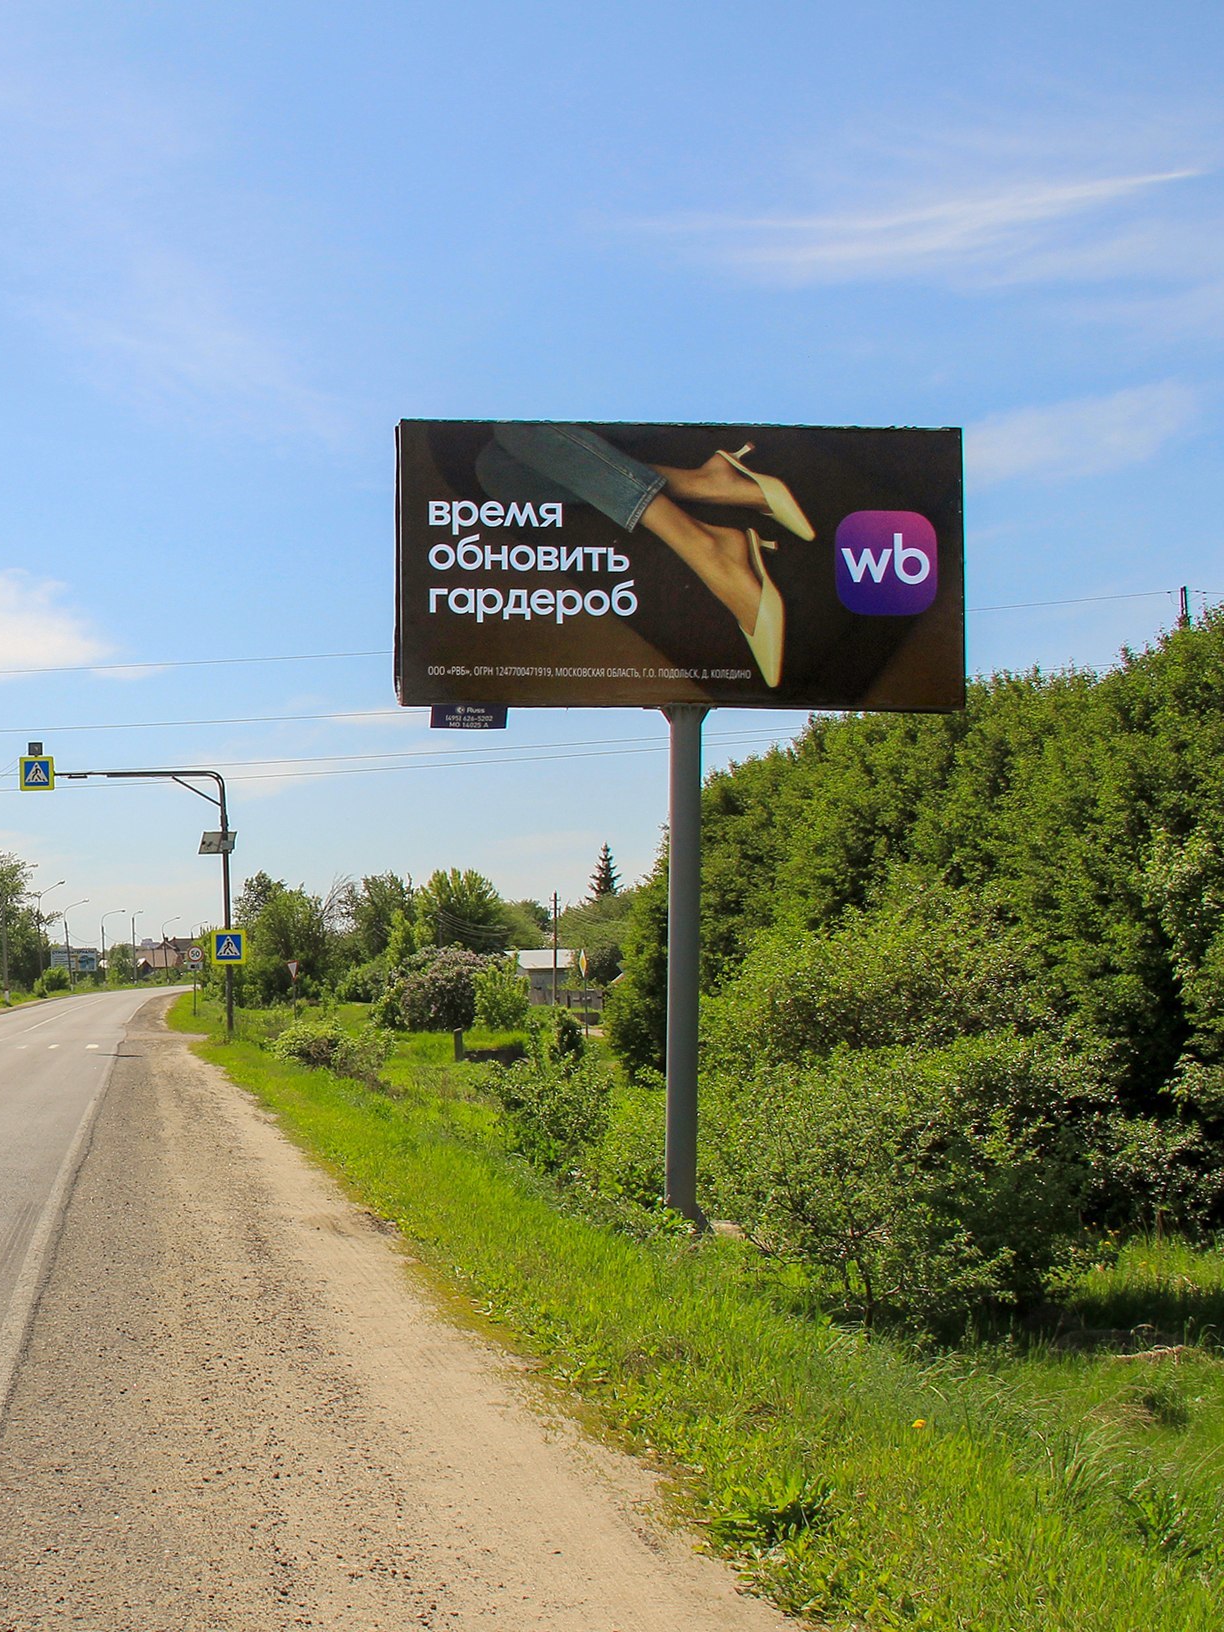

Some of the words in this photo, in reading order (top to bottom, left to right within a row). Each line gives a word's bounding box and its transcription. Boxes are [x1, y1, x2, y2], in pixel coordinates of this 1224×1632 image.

[428, 500, 563, 535] время
[428, 534, 630, 572] обновить
[841, 533, 930, 585] wb
[429, 580, 638, 624] гардероб
[428, 666, 445, 676] ООО
[474, 666, 494, 676] ОГРН
[556, 667, 605, 678] МОСКОВСКАЯ
[606, 668, 641, 679] ОБЛАСТЬ,
[658, 669, 699, 680] ПОДОЛЬСК,
[710, 669, 752, 680] КОЛЕДИНО
[467, 706, 485, 714] Russ
